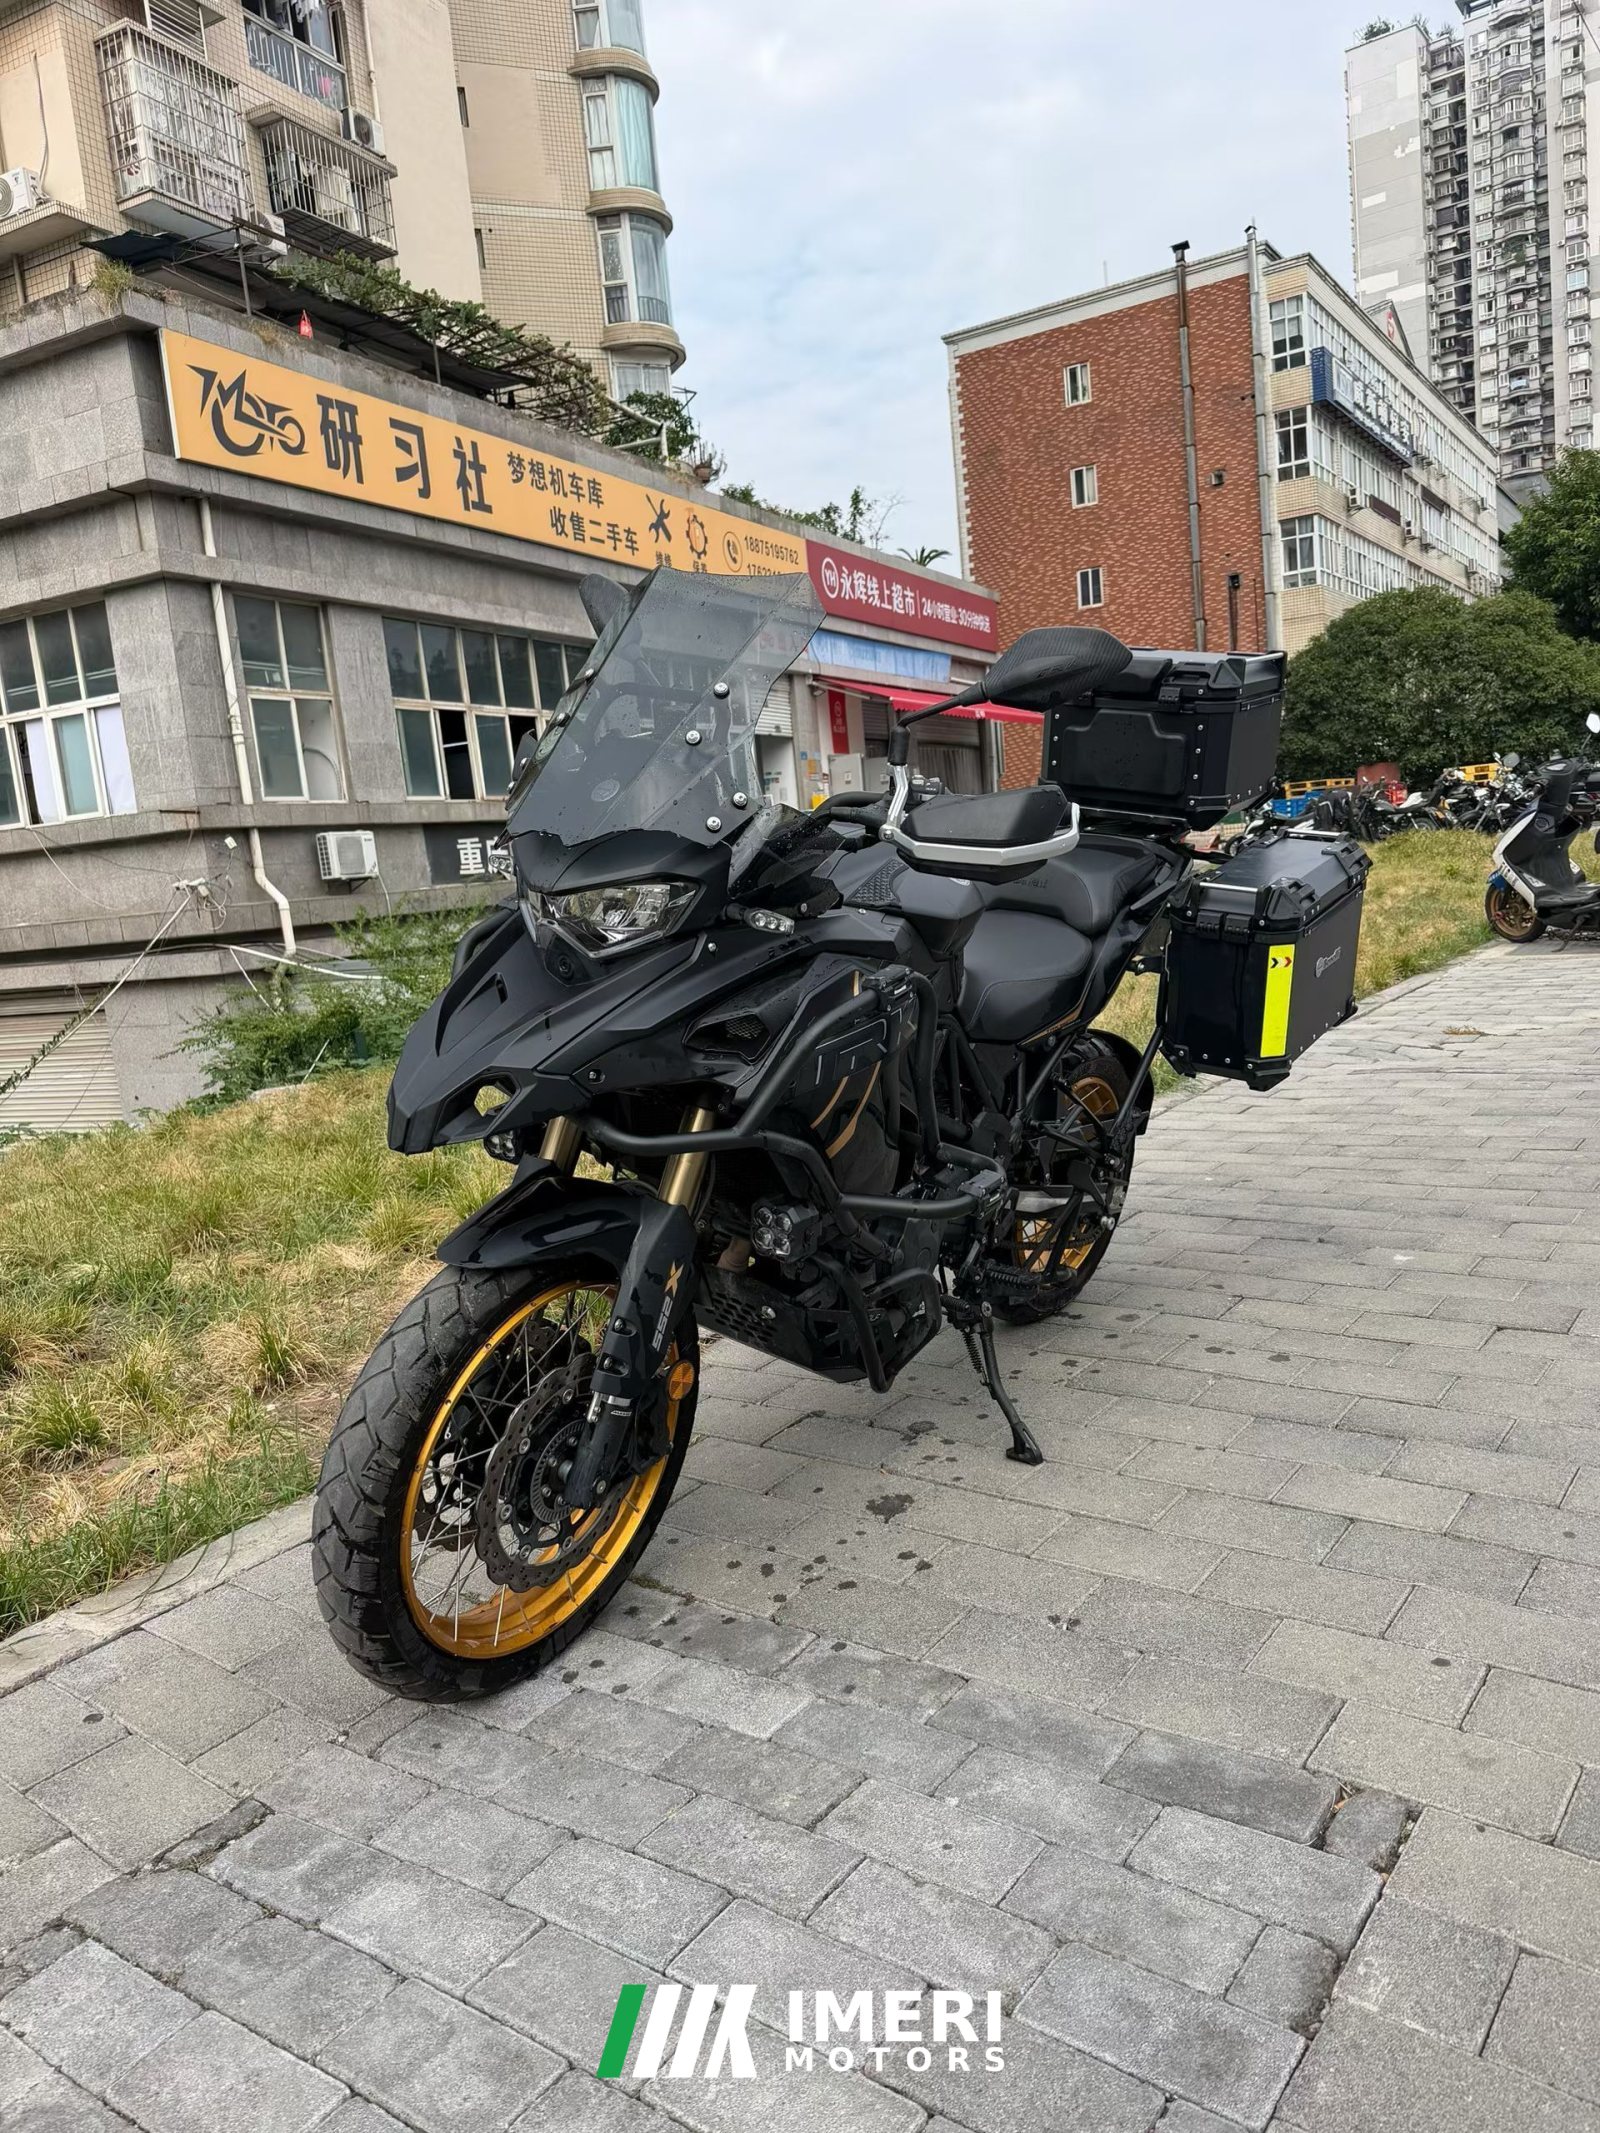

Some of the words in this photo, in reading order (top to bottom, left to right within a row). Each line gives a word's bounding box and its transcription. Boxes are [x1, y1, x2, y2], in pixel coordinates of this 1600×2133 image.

[316, 394, 493, 514] 研习社
[507, 451, 604, 509] 梦想机车库
[550, 506, 639, 556] 收售二手车
[744, 536, 799, 565] 18875195762
[840, 566, 915, 616] 永辉线上超市
